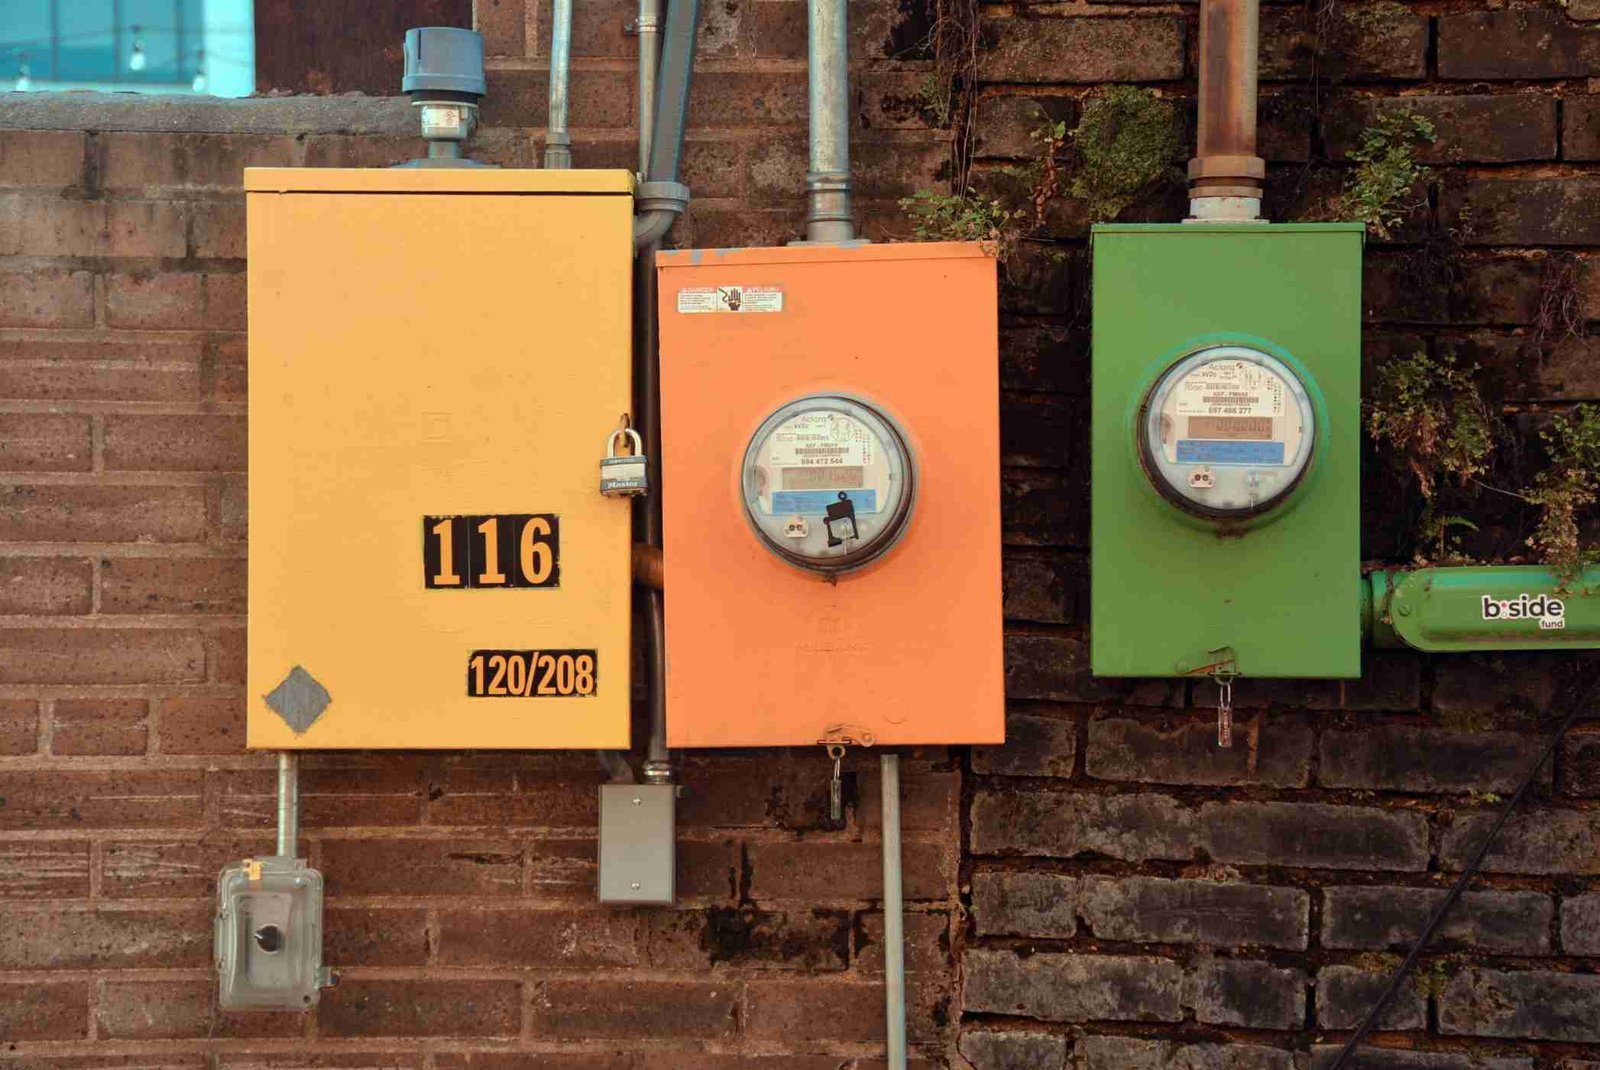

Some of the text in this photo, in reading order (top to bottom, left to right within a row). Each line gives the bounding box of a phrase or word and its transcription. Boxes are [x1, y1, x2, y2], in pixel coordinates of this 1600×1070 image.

[433, 517, 553, 585] 116
[1541, 620, 1563, 628] fund
[470, 652, 594, 697] 120/208
